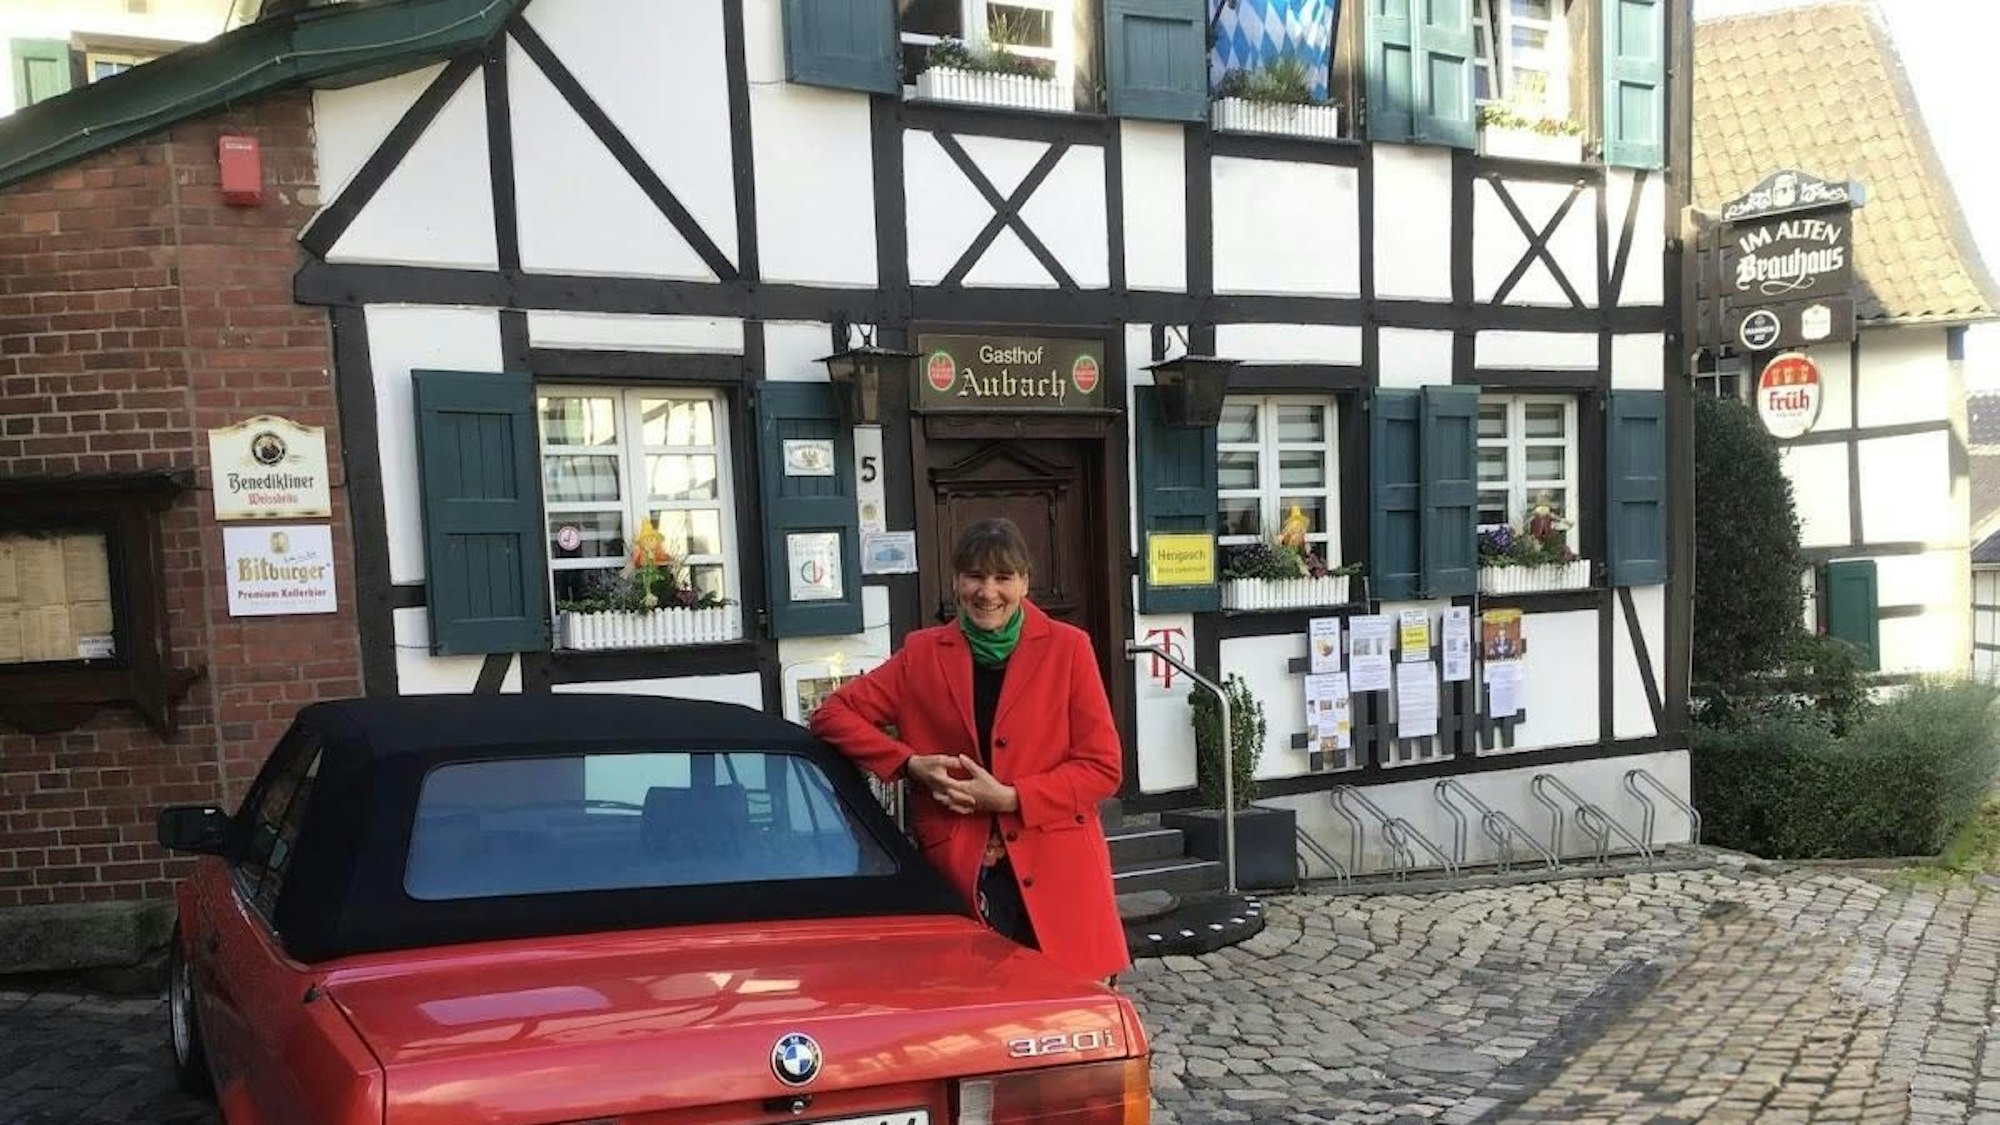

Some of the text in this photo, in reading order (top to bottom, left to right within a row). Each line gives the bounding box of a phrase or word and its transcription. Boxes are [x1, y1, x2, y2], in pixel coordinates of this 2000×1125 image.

[1740, 219, 1842, 254] IM ALTEN
[1736, 246, 1844, 292] Brauhaus
[978, 345, 1044, 365] Gasthof
[957, 367, 1067, 406] Aubach
[861, 456, 877, 482] 5
[237, 556, 326, 584] Bitburger
[238, 586, 327, 600] Premium Kellerbier
[1008, 1029, 1116, 1058] 320i
